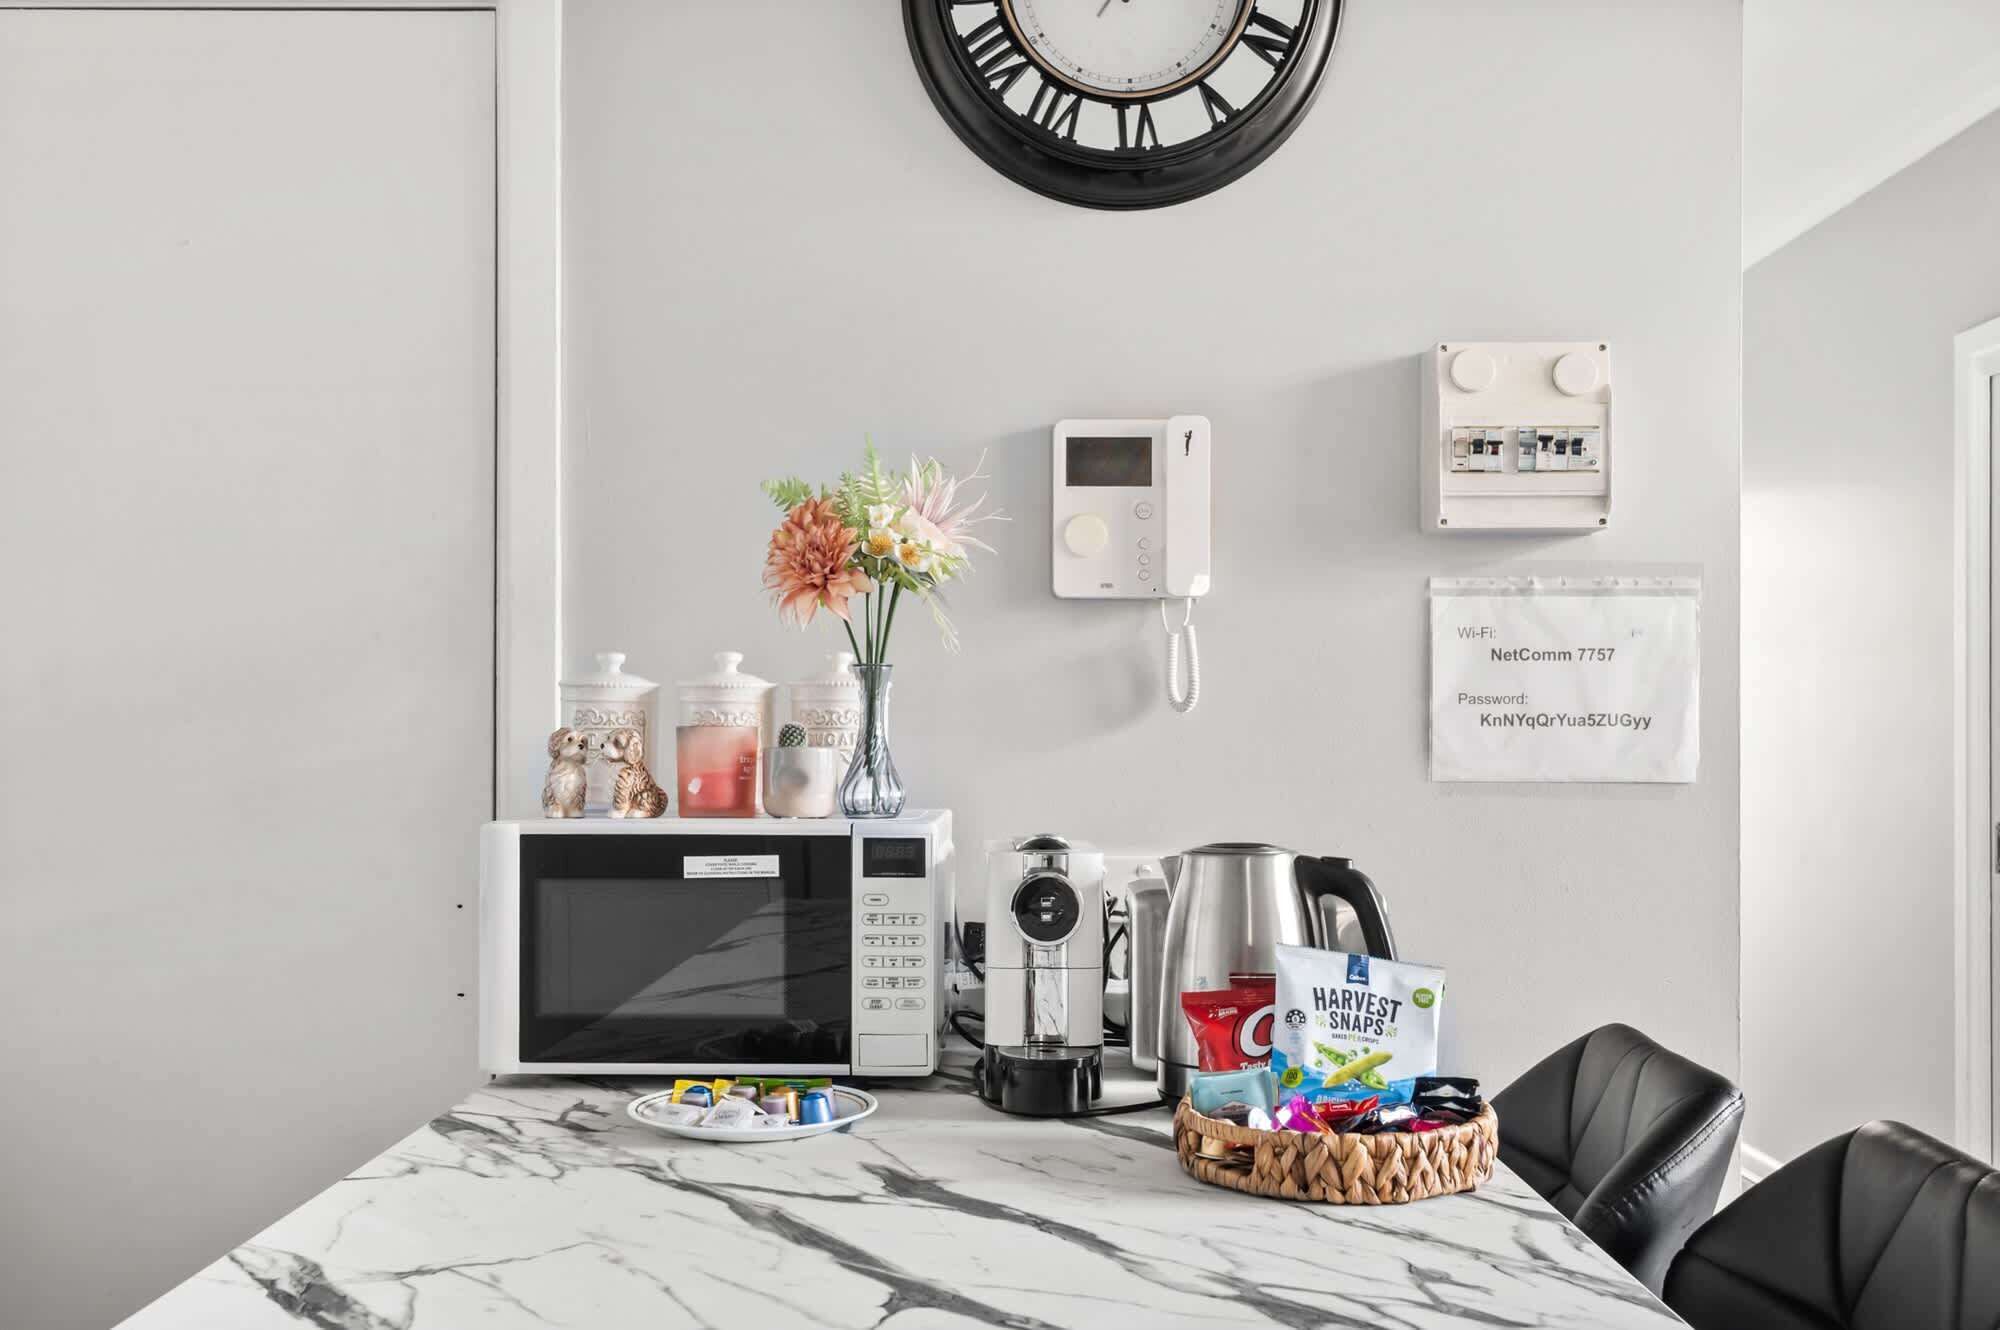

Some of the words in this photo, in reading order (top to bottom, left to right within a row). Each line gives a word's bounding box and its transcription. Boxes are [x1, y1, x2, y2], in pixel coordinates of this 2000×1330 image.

[1457, 626, 1496, 639] Wi-Fi:
[1491, 647, 1572, 661] NetComm
[1578, 648, 1615, 661] 7757
[1458, 692, 1528, 705] Password:
[1480, 713, 1652, 730] KnNYqQrYua5ZUGyy
[1312, 987, 1402, 1023] HARVEST
[1329, 1010, 1385, 1036] SNAPS
